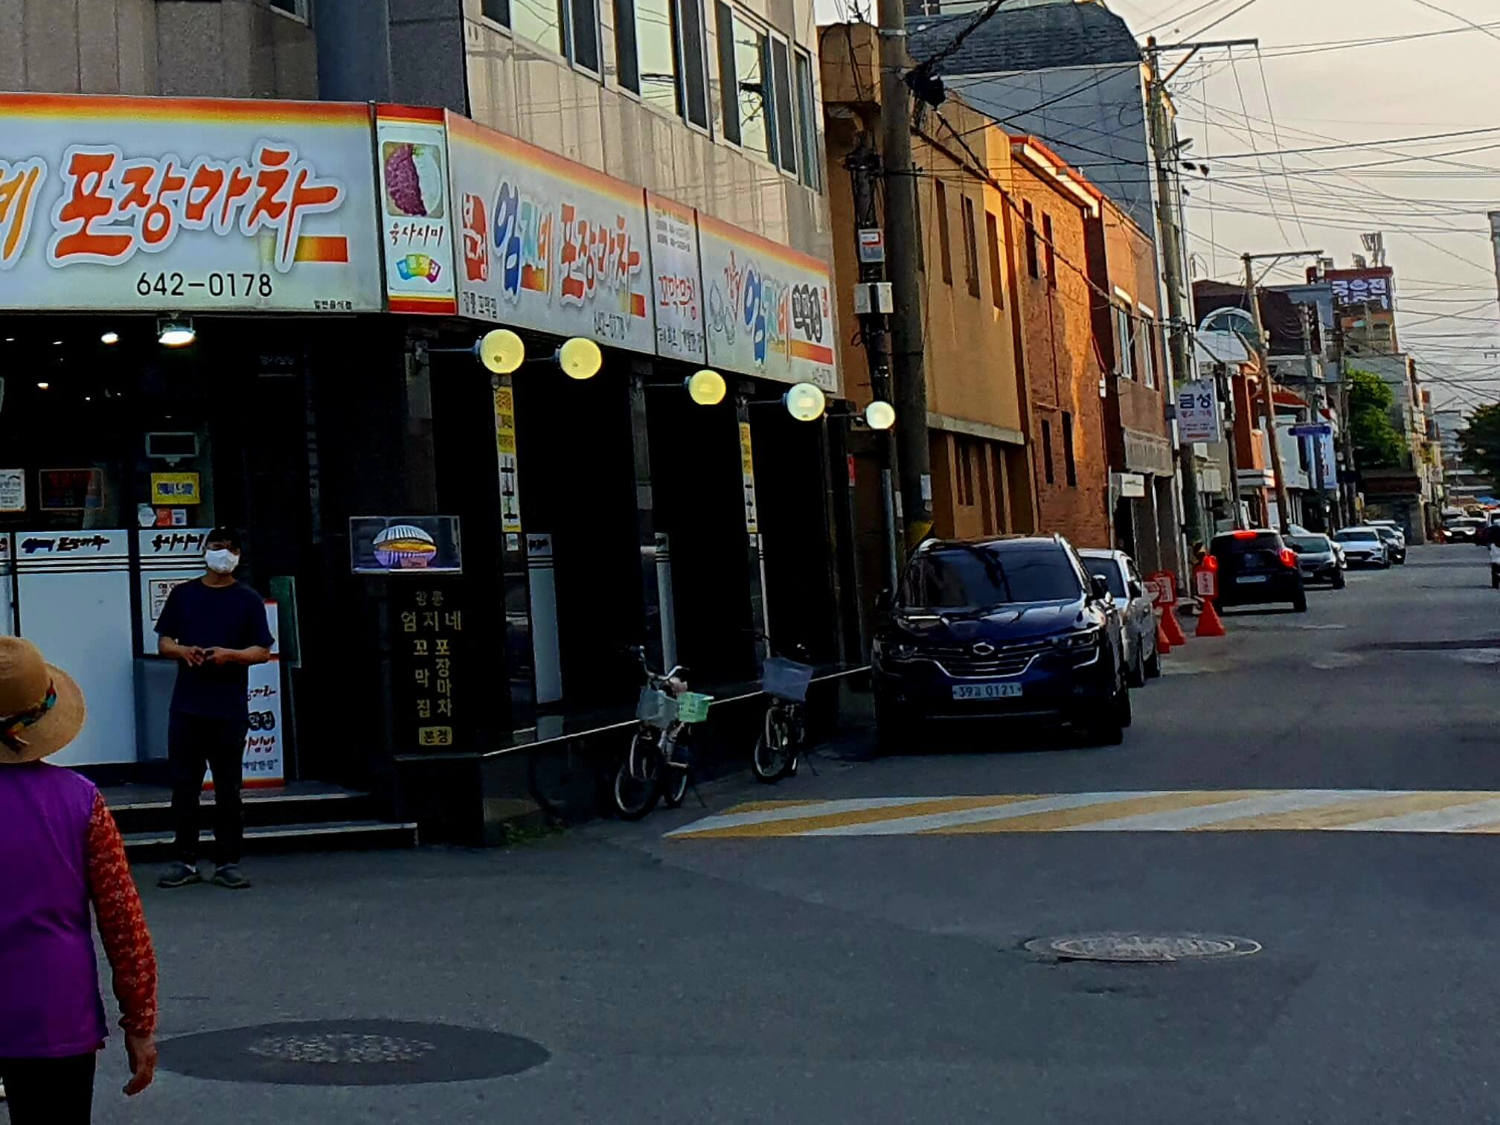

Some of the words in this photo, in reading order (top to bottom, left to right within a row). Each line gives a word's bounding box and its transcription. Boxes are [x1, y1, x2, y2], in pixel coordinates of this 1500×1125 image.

[53, 147, 340, 264] 포장마차
[388, 222, 444, 248] 육사시미
[493, 183, 553, 298] 엄지네
[560, 202, 641, 305] 포장마차
[135, 271, 274, 299] 642-0178
[400, 610, 463, 633] 엄지네
